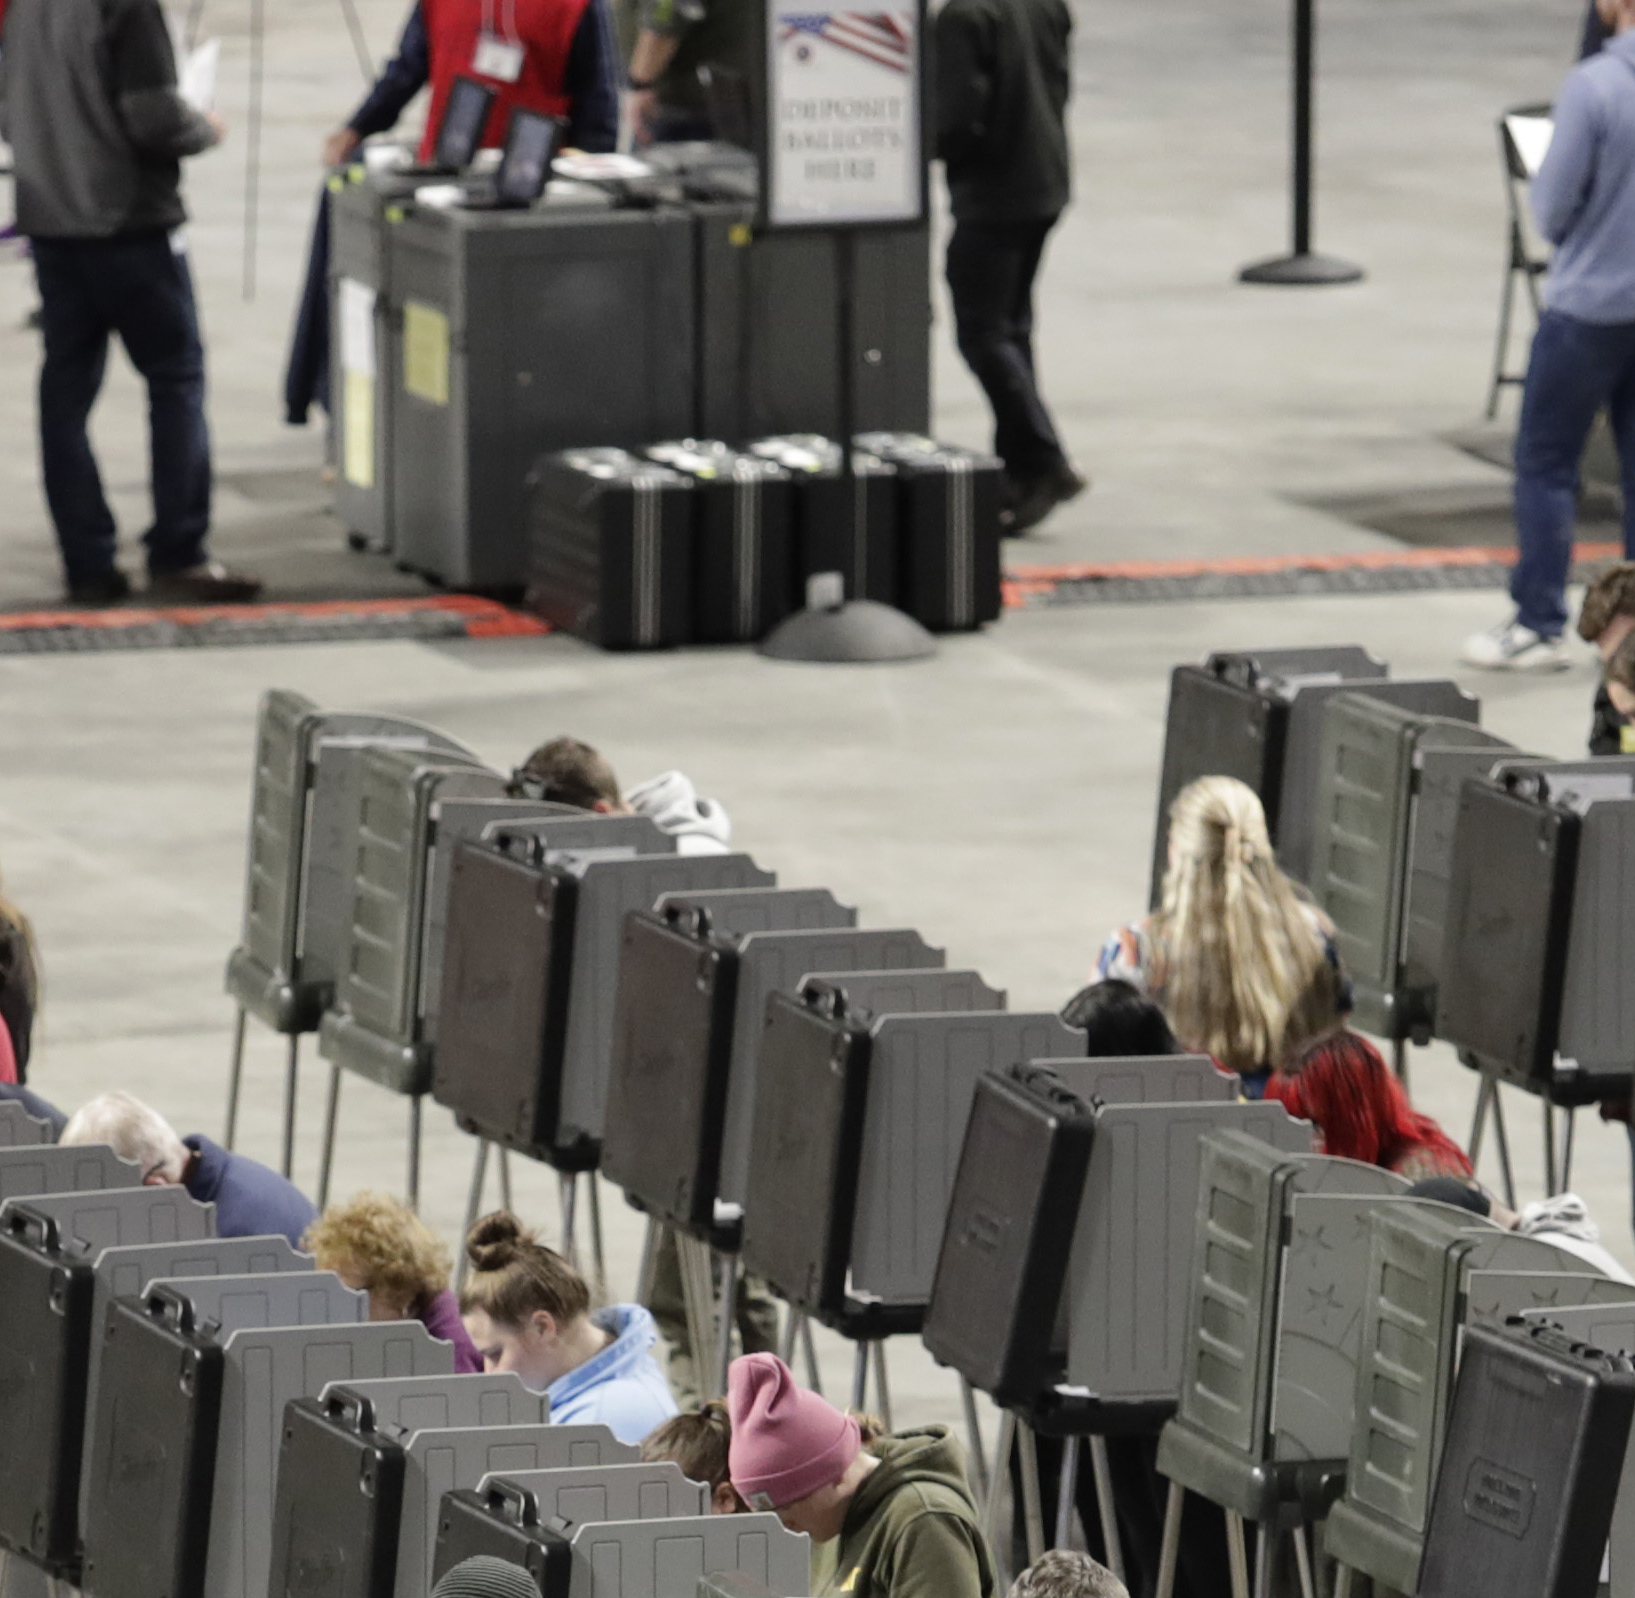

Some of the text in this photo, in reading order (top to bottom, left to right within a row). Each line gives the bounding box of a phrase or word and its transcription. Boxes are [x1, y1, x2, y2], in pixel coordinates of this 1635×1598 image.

[782, 97, 901, 120] DEPOSIT
[783, 126, 902, 151] BALLOTS
[804, 159, 875, 181] HERE
